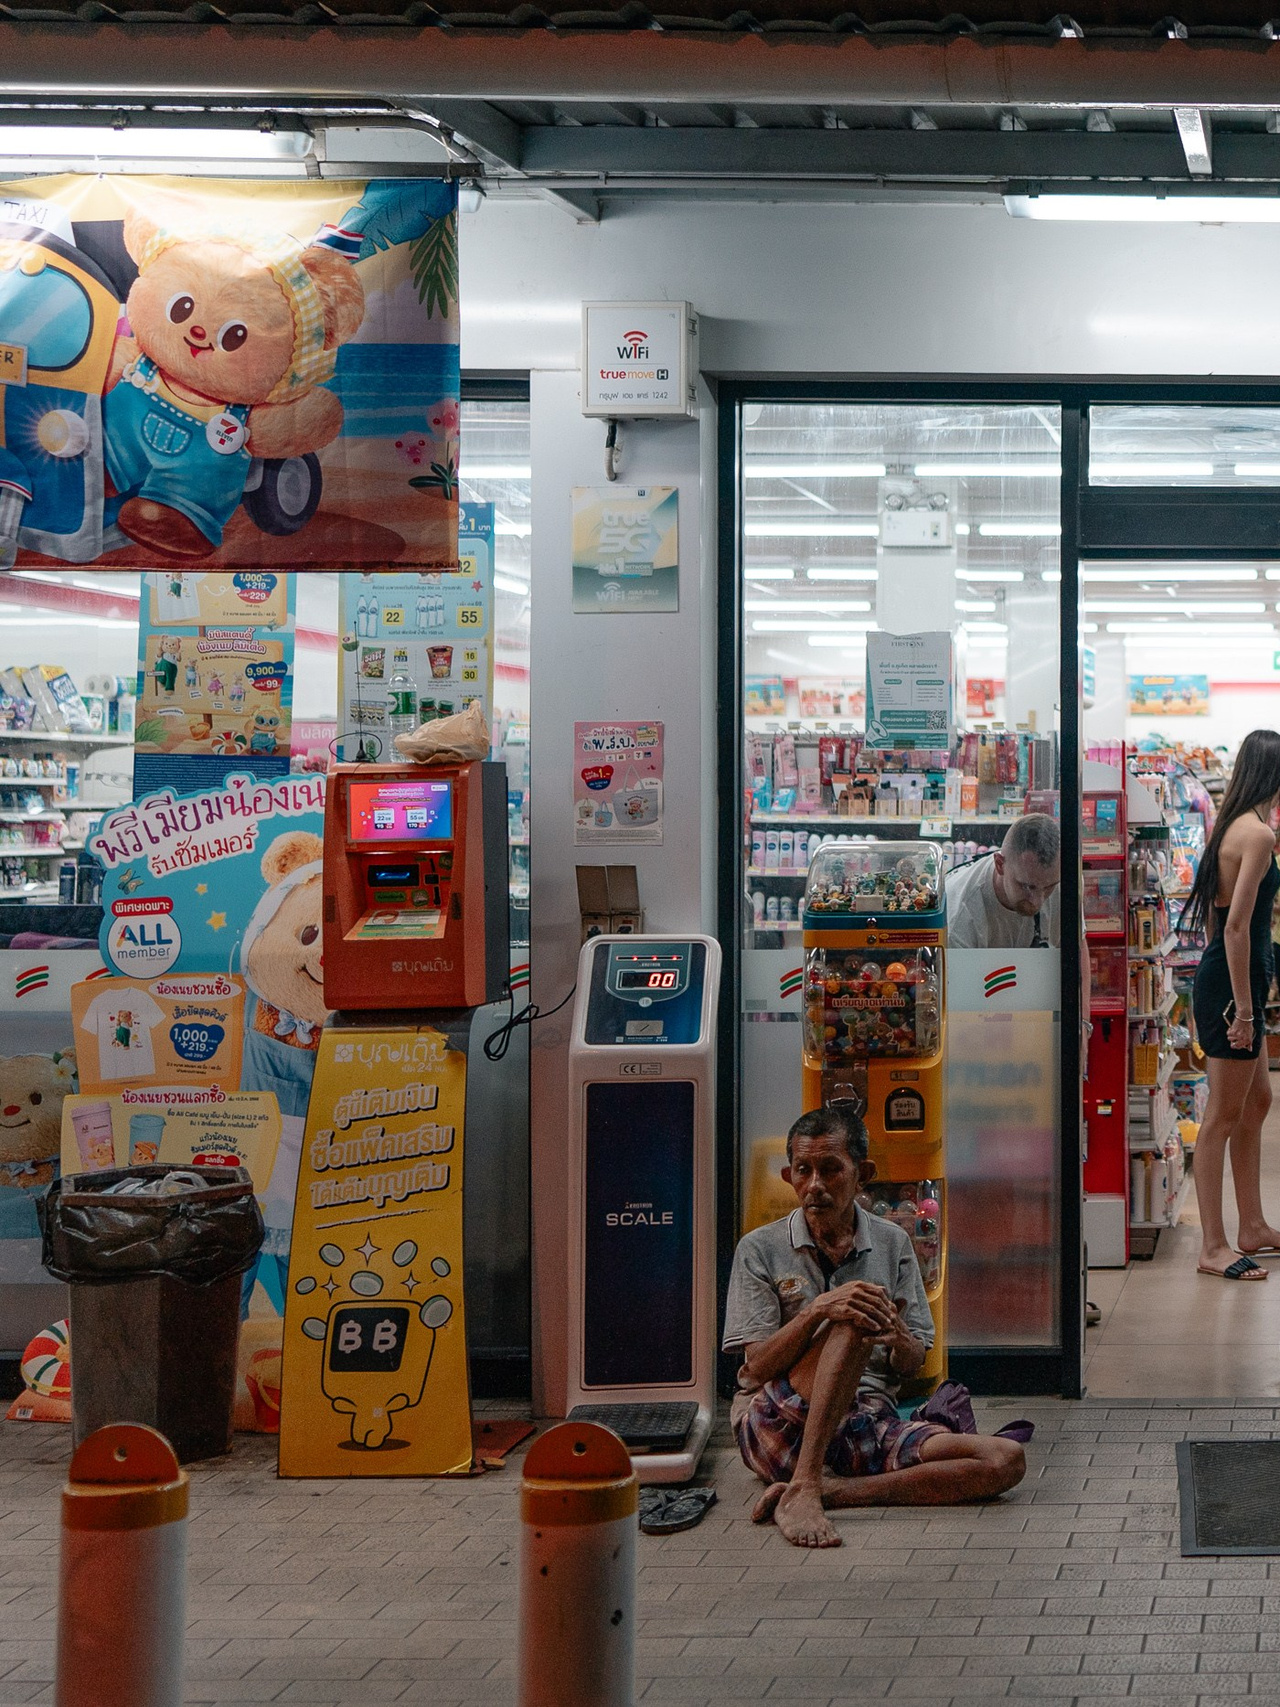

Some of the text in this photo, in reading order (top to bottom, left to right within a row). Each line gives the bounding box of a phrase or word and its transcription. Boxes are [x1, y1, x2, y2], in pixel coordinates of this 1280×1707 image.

[4, 201, 48, 225] TAXI
[469, 518, 476, 531] 1
[602, 509, 650, 527] true
[598, 527, 652, 553] 5G
[386, 612, 400, 623] 22
[461, 611, 478, 623] 55
[247, 666, 274, 676] 9,900
[464, 671, 475, 679] 30
[962, 791, 975, 801] UV
[151, 825, 257, 875] รับซัมเมอร์
[115, 901, 170, 913] พิเศษเฉพาะ
[116, 923, 173, 947] ALL
[118, 946, 171, 959] member
[157, 977, 231, 995] น้องเนยชวนซื้อ
[173, 1028, 208, 1042] 1,000
[181, 1041, 214, 1052] +219.-
[417, 1062, 432, 1072] 24
[623, 1065, 636, 1074] CE
[122, 1086, 226, 1104] น้องเนยชวนแลกซื้อ
[606, 1211, 674, 1226] SCALE
